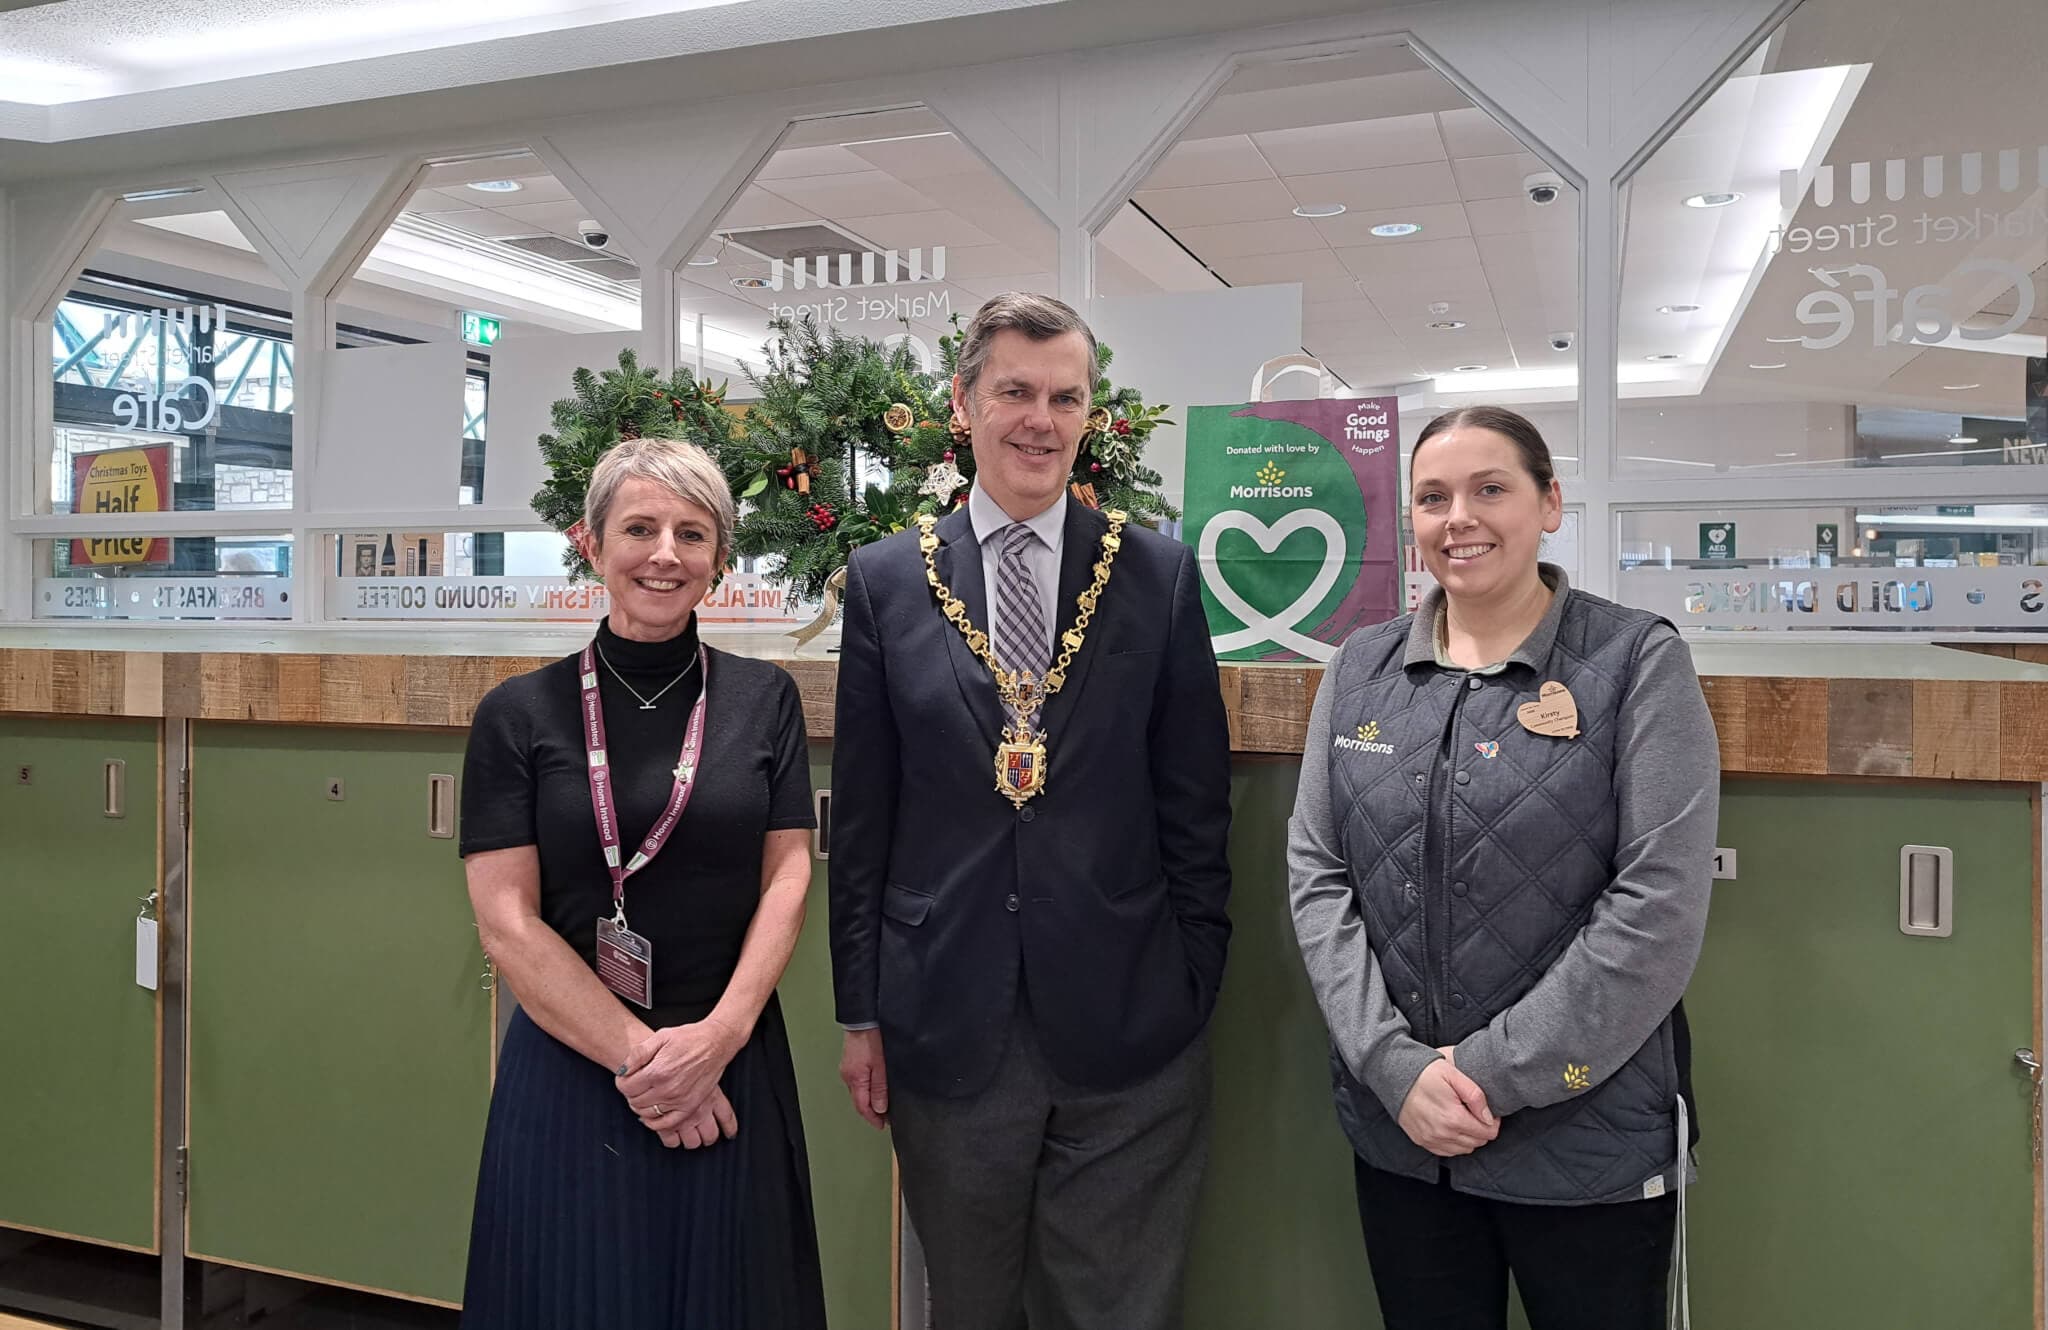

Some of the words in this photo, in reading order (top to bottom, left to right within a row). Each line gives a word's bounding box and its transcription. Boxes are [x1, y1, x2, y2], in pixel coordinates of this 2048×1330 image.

[1357, 401, 1381, 411] Make
[1346, 411, 1387, 426] Good
[1344, 427, 1390, 443] Things
[1226, 444, 1262, 455] Donated
[1264, 443, 1284, 453] with
[1286, 443, 1306, 453] love
[1307, 443, 1320, 454] by
[1352, 444, 1385, 456] Happen
[89, 466, 128, 478] Christmas
[130, 463, 147, 476] Toys
[96, 484, 141, 513] Half
[1230, 483, 1313, 498] Morrisons
[588, 701, 596, 721] Home
[1540, 711, 1560, 720] Kirsty
[590, 721, 600, 747] Instead
[1334, 734, 1394, 755] Morrisons
[331, 783, 338, 796] 4
[596, 782, 605, 807] Home
[653, 816, 673, 840] Home
[669, 786, 686, 816] Instead
[600, 807, 612, 840] Instead
[1713, 855, 1722, 872] 1
